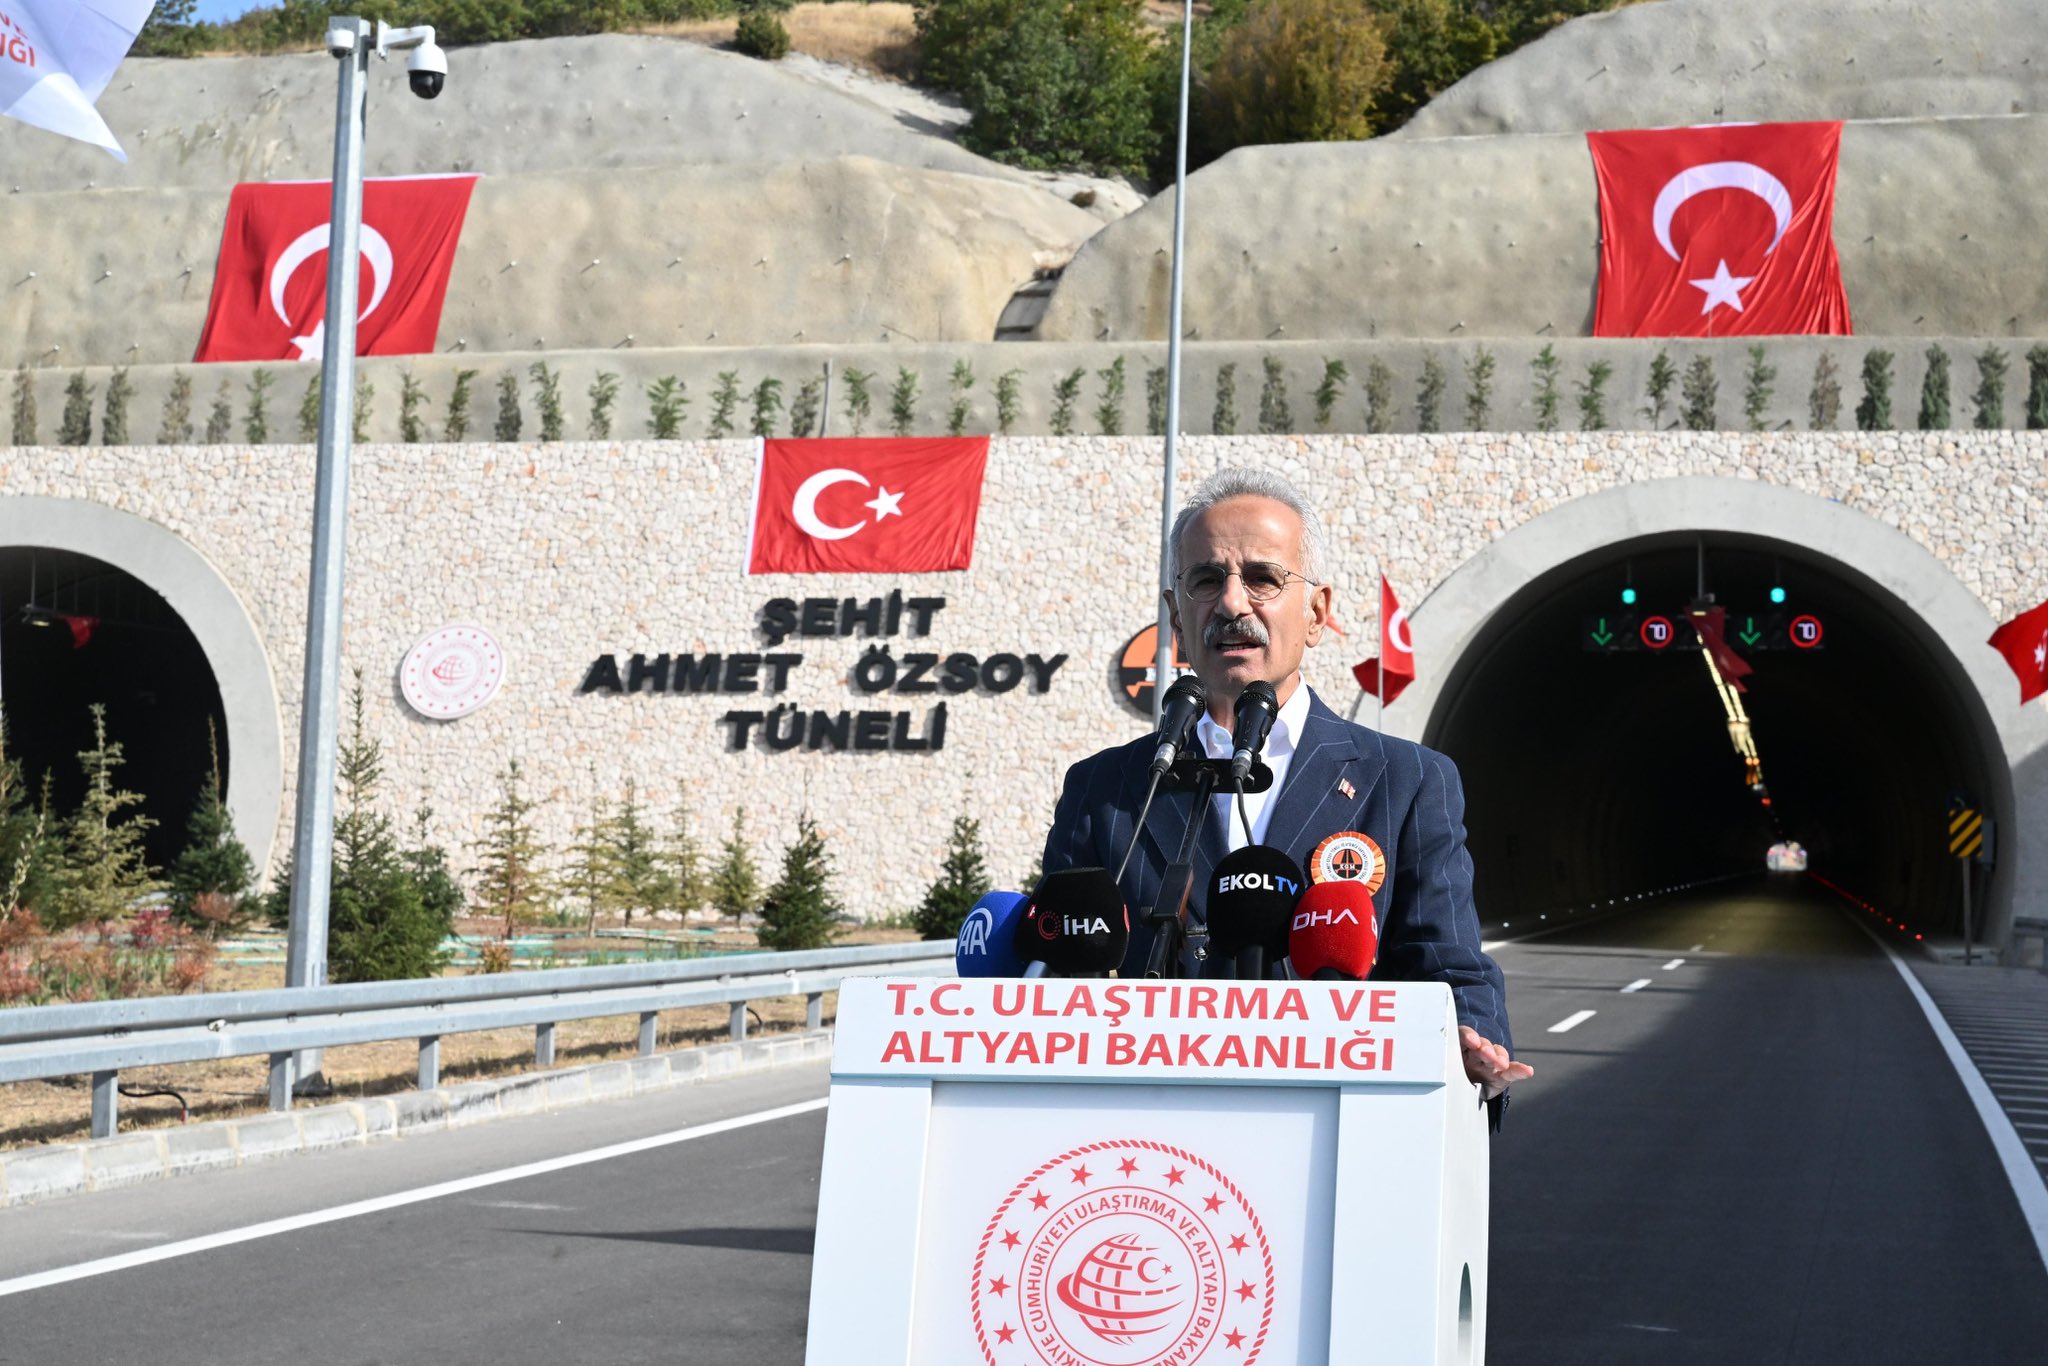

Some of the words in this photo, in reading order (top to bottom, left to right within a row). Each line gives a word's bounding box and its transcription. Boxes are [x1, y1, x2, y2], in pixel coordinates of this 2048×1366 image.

[761, 588, 946, 646] ŞEHİT
[1648, 623, 1667, 640] 70
[1798, 623, 1816, 640] 70
[580, 653, 803, 692] AHMET
[855, 644, 1069, 693] ÖZSOY
[725, 701, 947, 750] TÜNELİ
[957, 919, 988, 957] AA
[1063, 915, 1111, 936] İHA
[1292, 908, 1359, 931] DHA
[886, 983, 975, 1016] T.C.
[993, 984, 1309, 1027] ULAŞTIRMA
[1329, 989, 1396, 1023] VE
[880, 1031, 1089, 1065] ALTYAPI
[1106, 1030, 1394, 1071] BAKANLIĞI
[1027, 1212, 1075, 1333] CUMHURİYETİ
[1074, 1194, 1177, 1222] ULAŞTIRMA
[1178, 1216, 1200, 1240] VE
[1192, 1241, 1218, 1313] ALTYAPI
